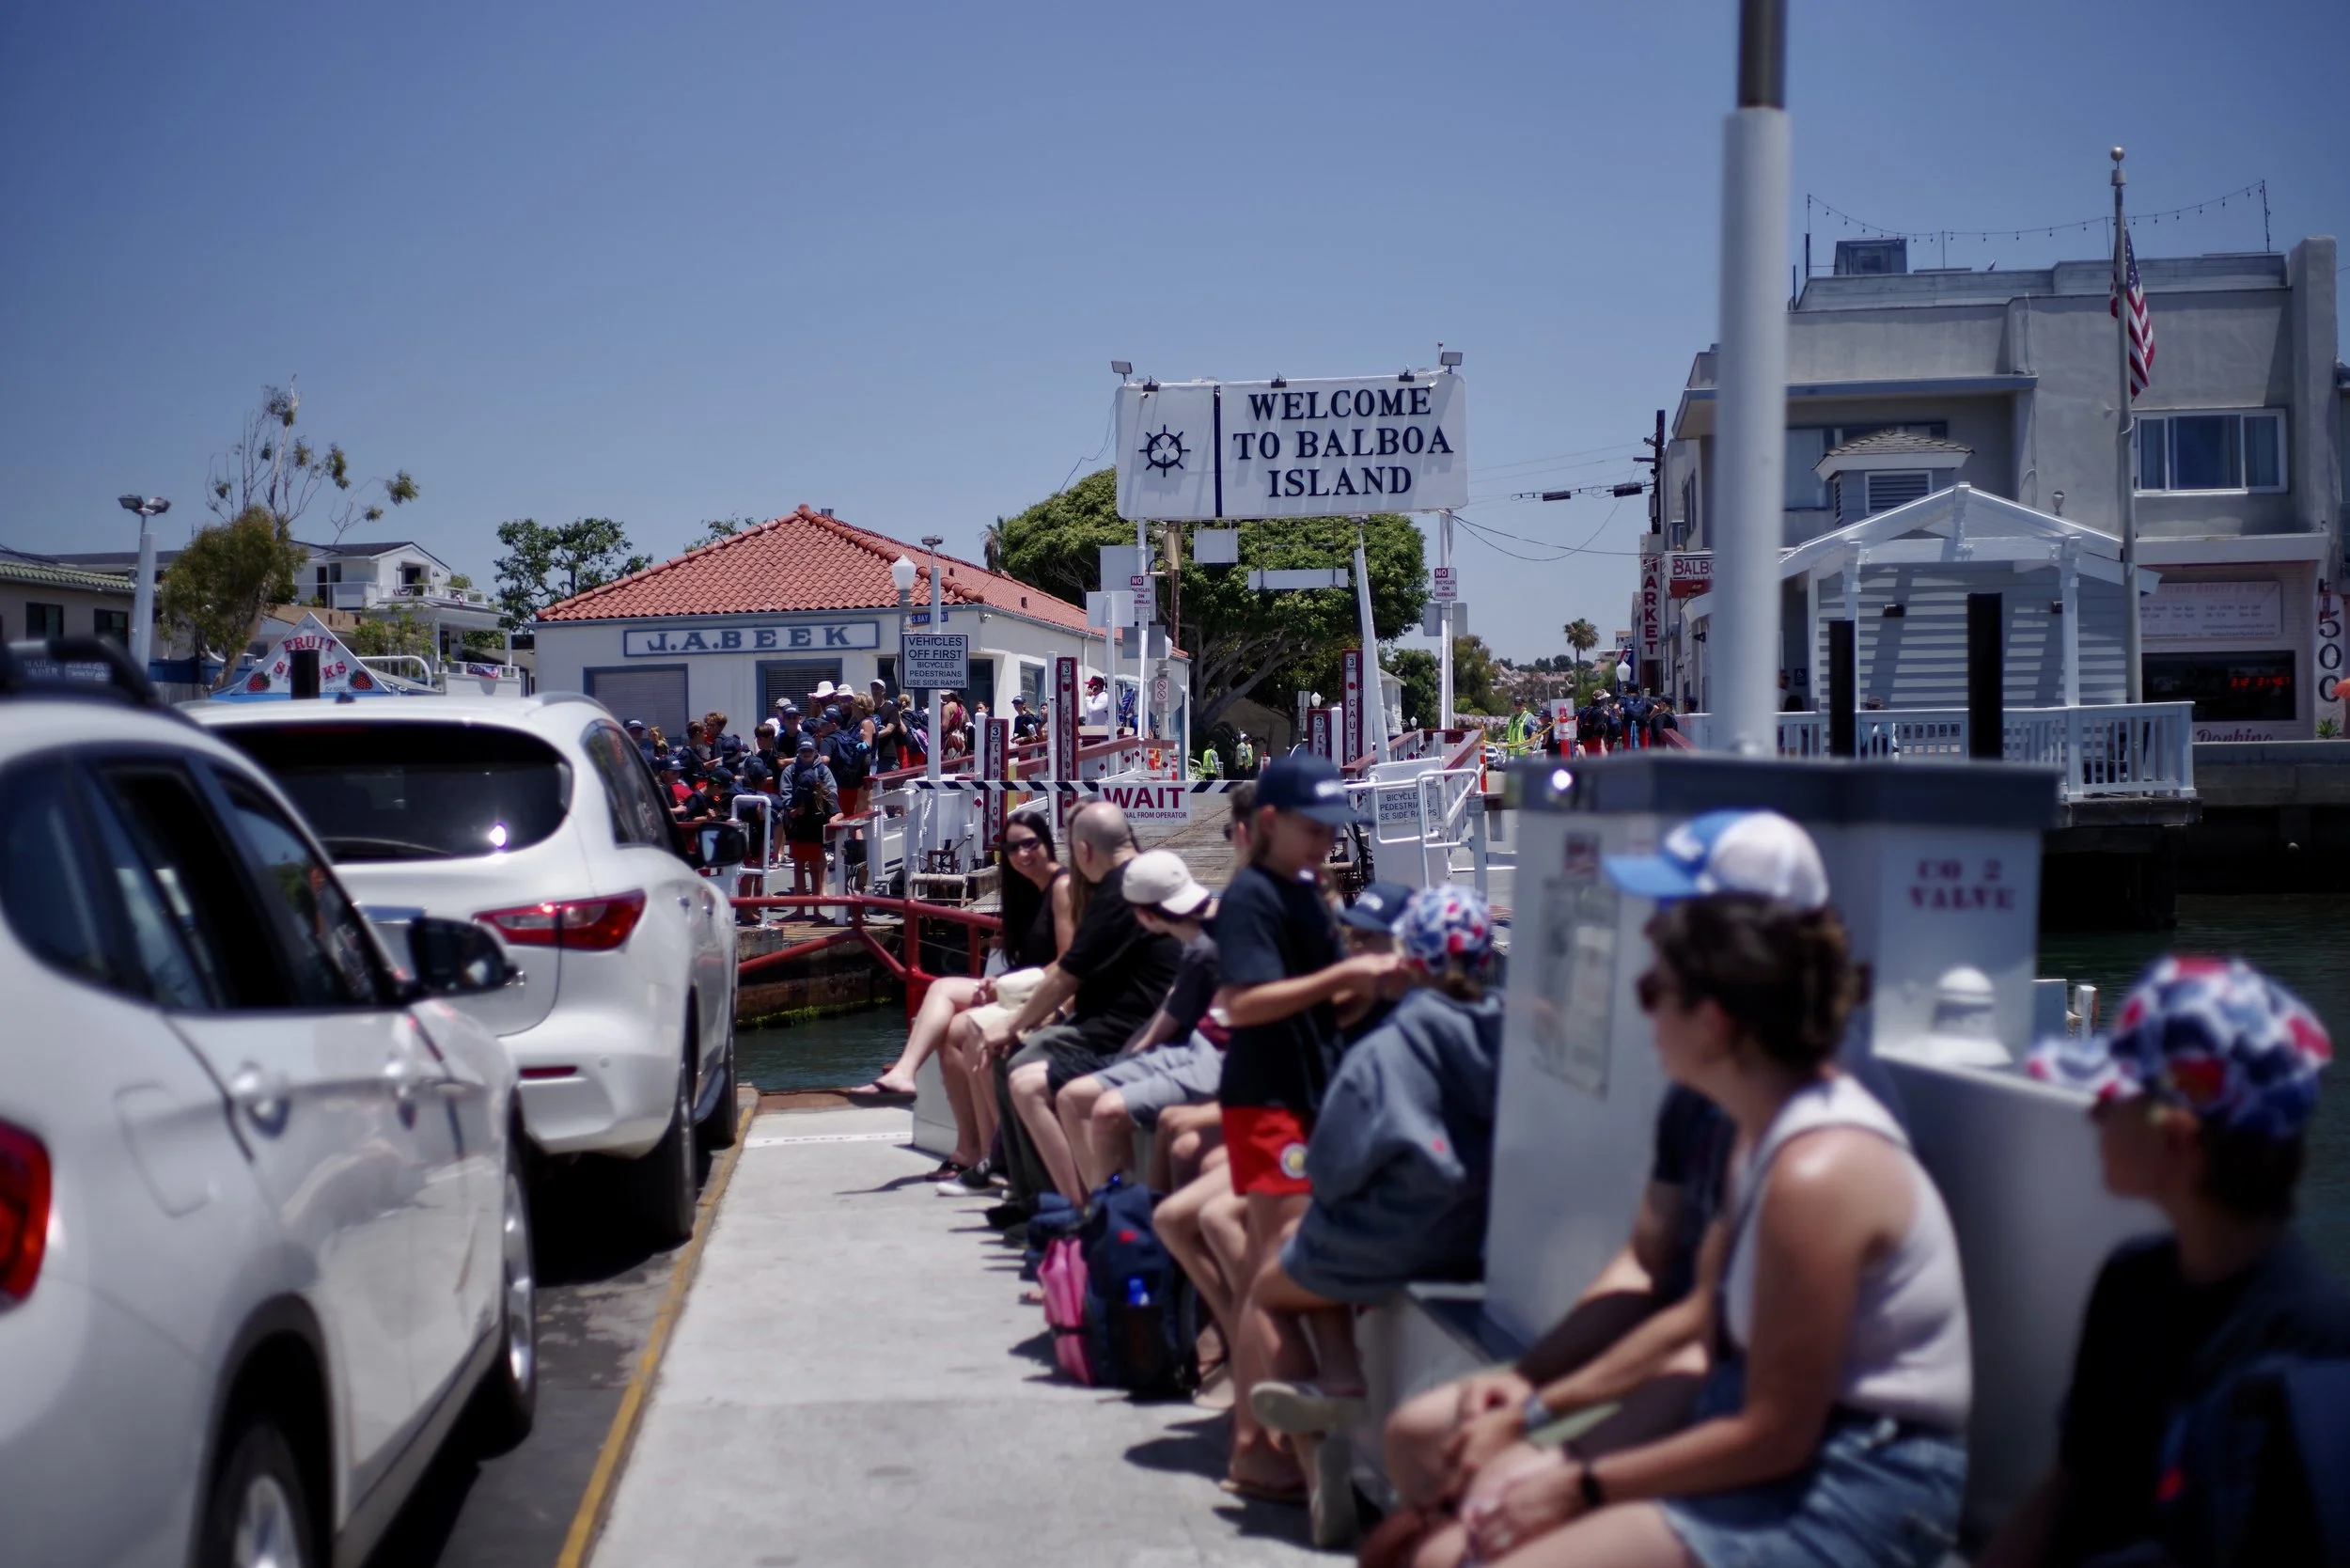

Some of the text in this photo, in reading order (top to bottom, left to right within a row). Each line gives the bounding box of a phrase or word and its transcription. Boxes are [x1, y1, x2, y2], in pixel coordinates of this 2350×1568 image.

[1248, 386, 1432, 421] WELCOME
[1233, 426, 1454, 461] TO BALBOA
[1268, 466, 1412, 498] ISLAND
[1435, 569, 1447, 577] NO
[1132, 576, 1143, 585] NO
[283, 635, 337, 653] FRUIT
[908, 637, 963, 647] VEHICLES
[908, 650, 963, 658] OFF FIRST
[993, 727, 998, 736] 3
[1103, 786, 1186, 808] WAIT
[1386, 792, 1418, 801] BICYCLE
[1391, 810, 1408, 819] SIDE
[1917, 857, 2002, 881] CO 2
[1907, 886, 2016, 910] VALVE
